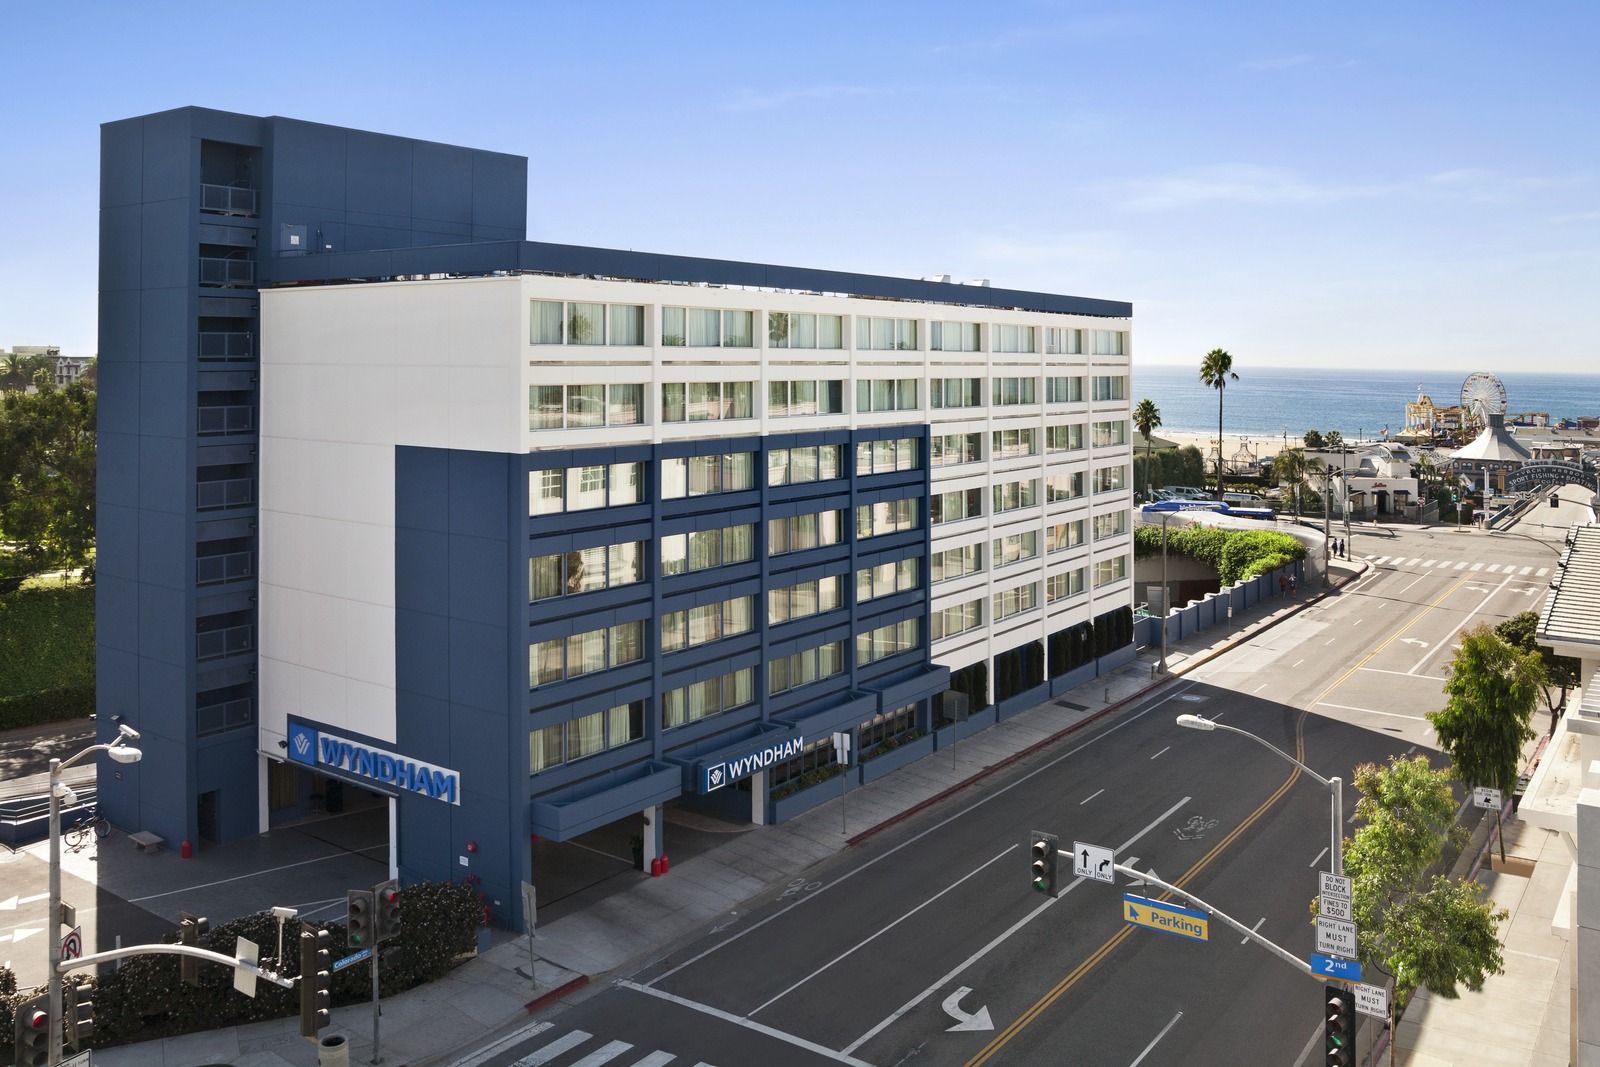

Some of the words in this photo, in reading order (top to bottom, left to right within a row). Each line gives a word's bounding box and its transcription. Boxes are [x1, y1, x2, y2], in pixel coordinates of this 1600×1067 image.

[1508, 475, 1529, 486] SPORT
[1566, 475, 1596, 491] BOATING
[729, 736, 804, 779] WYNDHAM
[320, 737, 456, 803] WYNDHAM
[1077, 868, 1092, 876] ONLY
[1097, 872, 1112, 880] ONLY
[1325, 875, 1334, 883] DO
[1325, 882, 1346, 894] BLOCK
[1322, 890, 1350, 900] INTERSECTION
[1324, 899, 1340, 908] FINES
[1341, 902, 1348, 910] TO
[1326, 906, 1345, 917] $500
[1151, 911, 1202, 936] Parking
[1319, 920, 1336, 929] RIGHT
[1338, 924, 1354, 934] LANE
[1326, 932, 1347, 943] MUST
[1319, 941, 1335, 950] TURN
[1336, 945, 1354, 955] RIGHT
[1324, 959, 1347, 973] 2nd
[1355, 985, 1370, 994] RIGHT
[1371, 989, 1385, 998] LANE
[1361, 995, 1380, 1005] MUST
[1355, 1002, 1370, 1011] TURN
[1370, 1005, 1386, 1016] RIGHT
